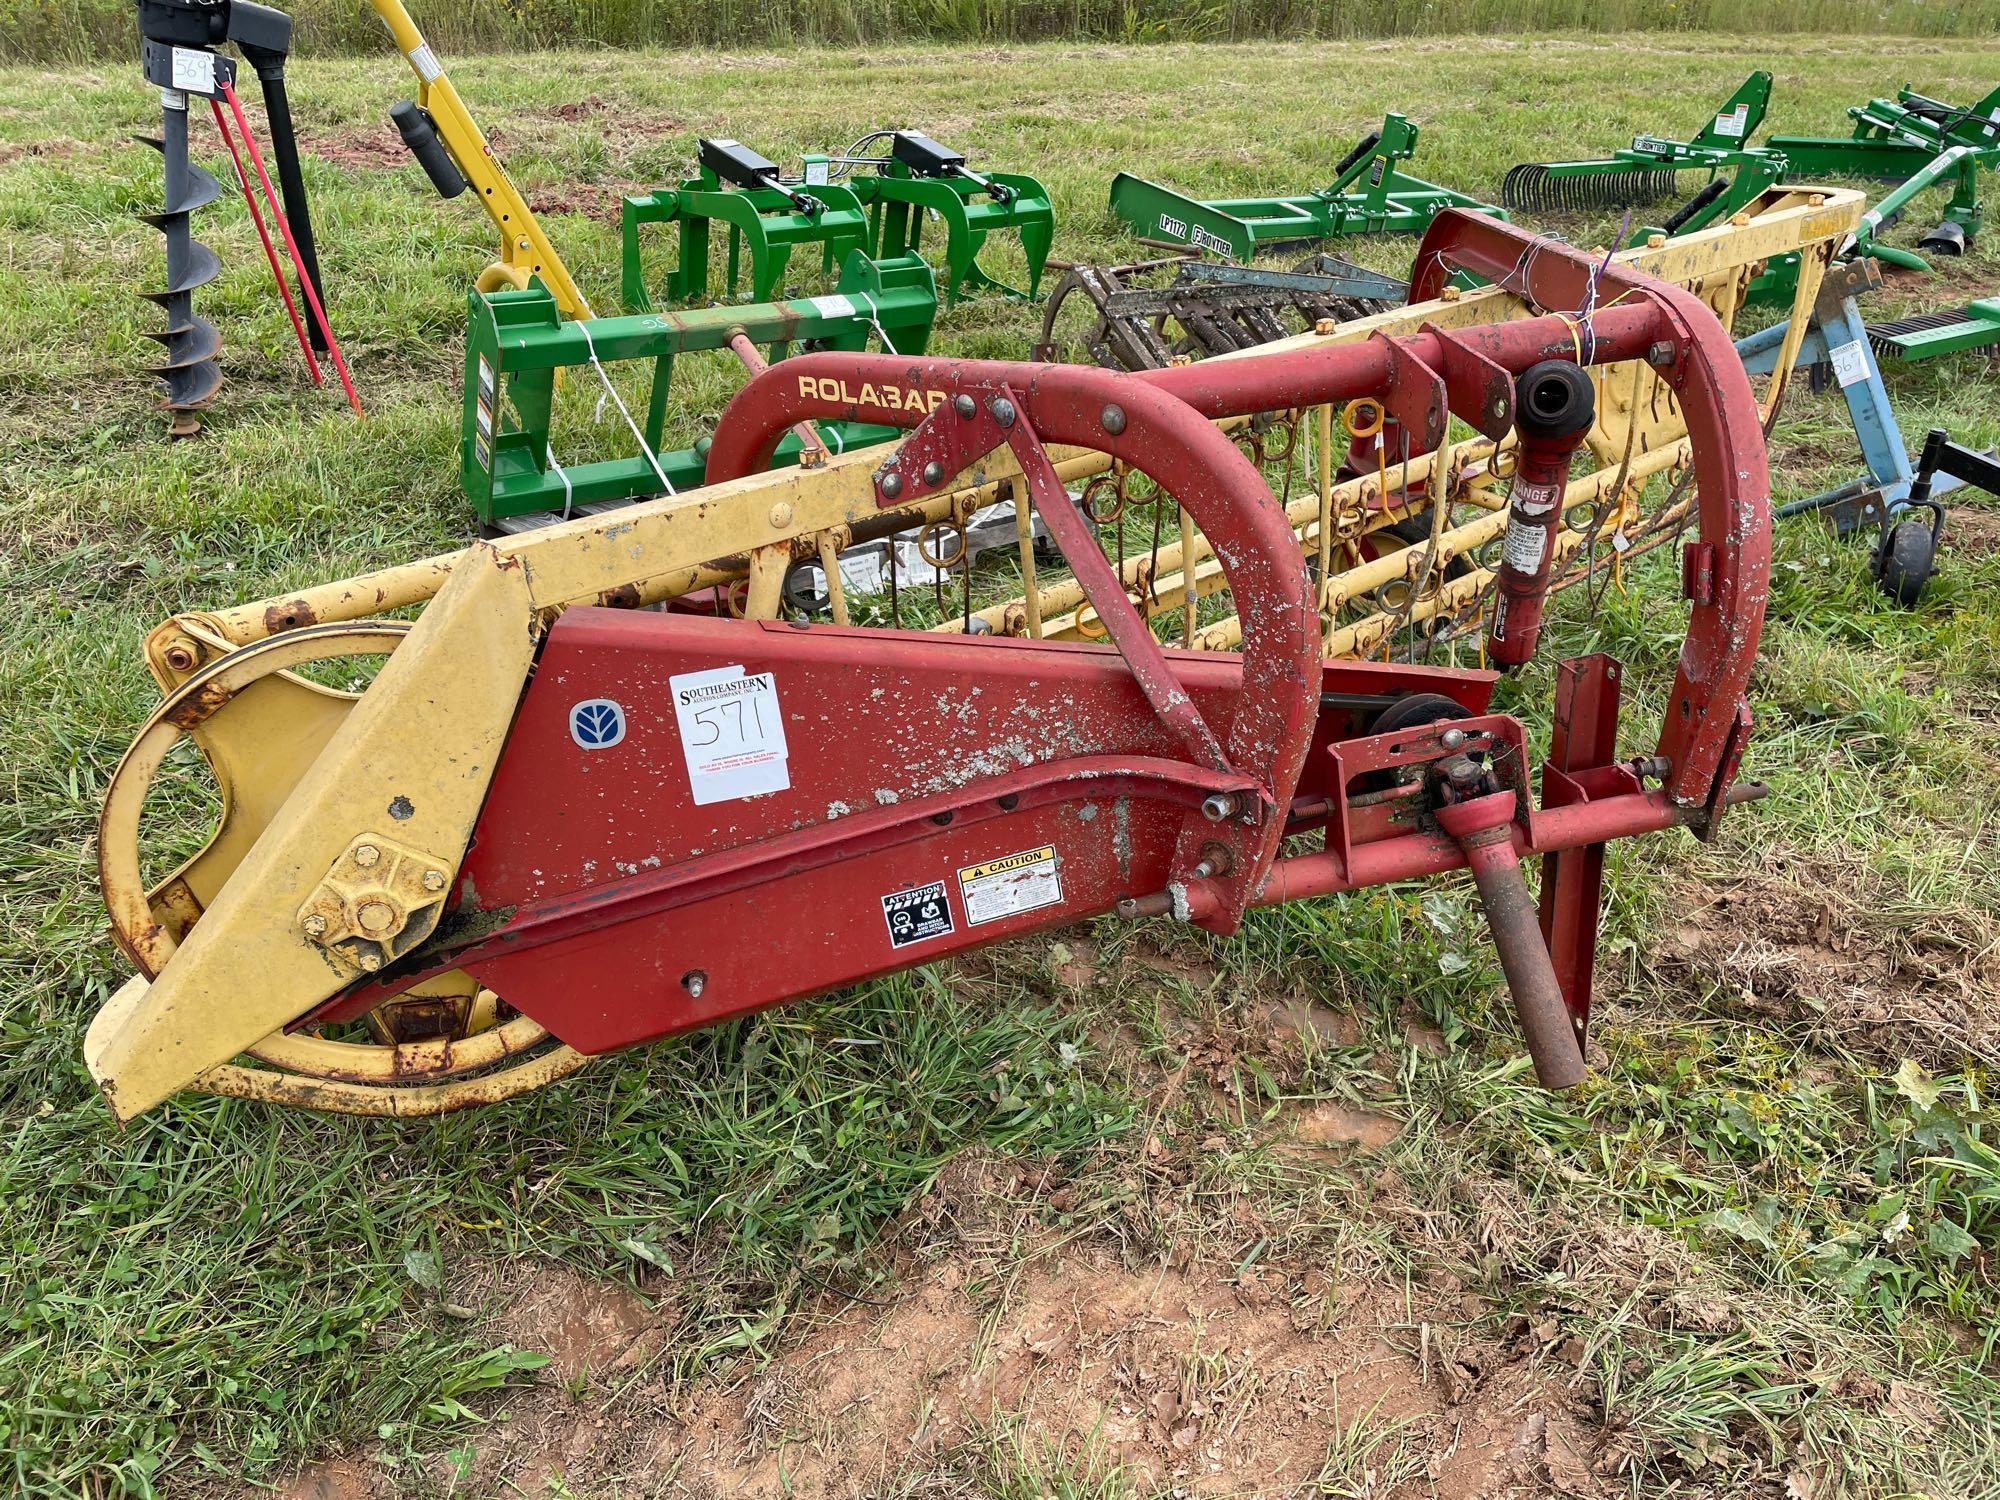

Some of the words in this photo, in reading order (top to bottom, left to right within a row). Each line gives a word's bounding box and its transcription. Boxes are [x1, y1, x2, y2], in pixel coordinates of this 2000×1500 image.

[175, 58, 207, 81] 569
[1160, 215, 1186, 238] LP1172
[1192, 225, 1231, 256] FRONTIER
[1832, 351, 1861, 375] 567
[679, 675, 768, 706] SOUTHEASTERN
[693, 695, 717, 704] AUCTION
[692, 697, 764, 746] 571
[989, 852, 1042, 872] CAUTION
